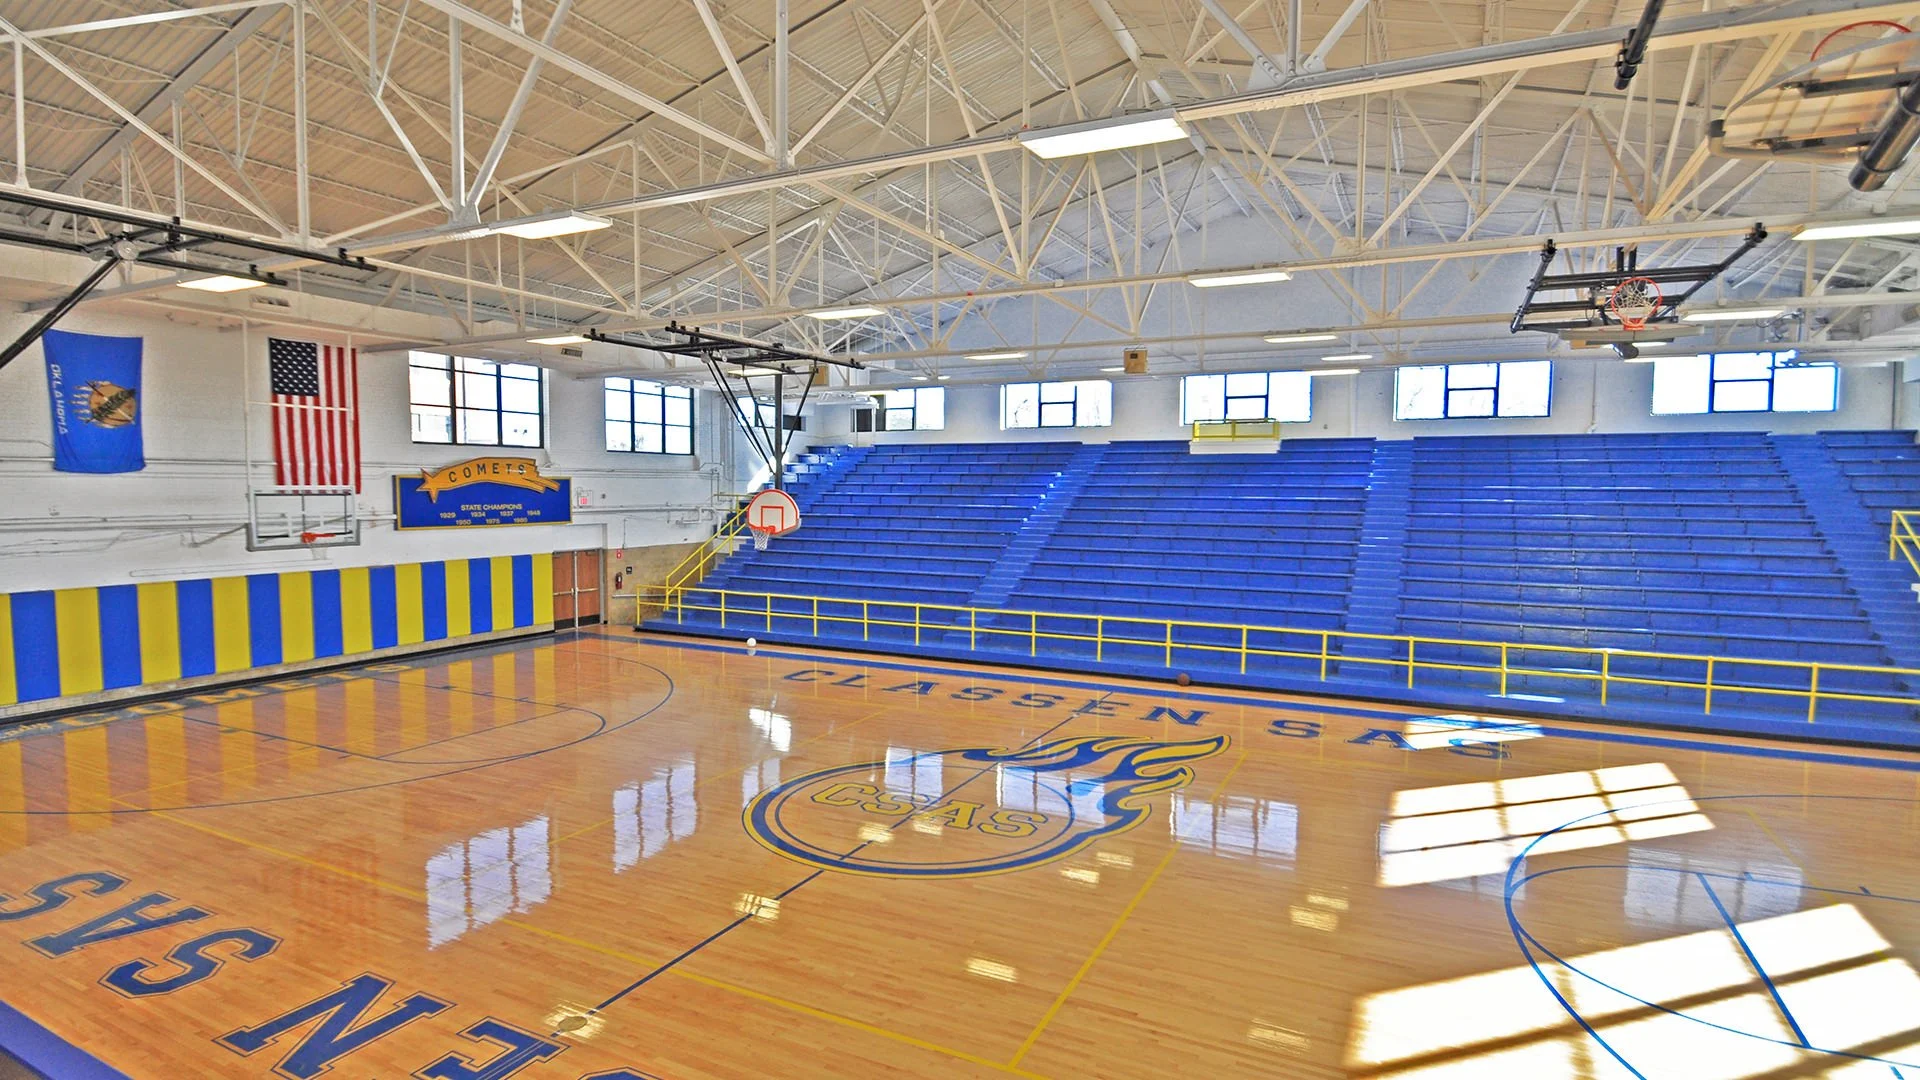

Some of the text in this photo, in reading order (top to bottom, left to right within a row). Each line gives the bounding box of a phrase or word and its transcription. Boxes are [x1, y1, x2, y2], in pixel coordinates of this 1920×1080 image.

[50, 364, 68, 435] OKLAHOMA
[448, 462, 525, 483] COMETS
[783, 668, 1513, 760] CLASSEN SAS
[811, 783, 1048, 839] CSAS
